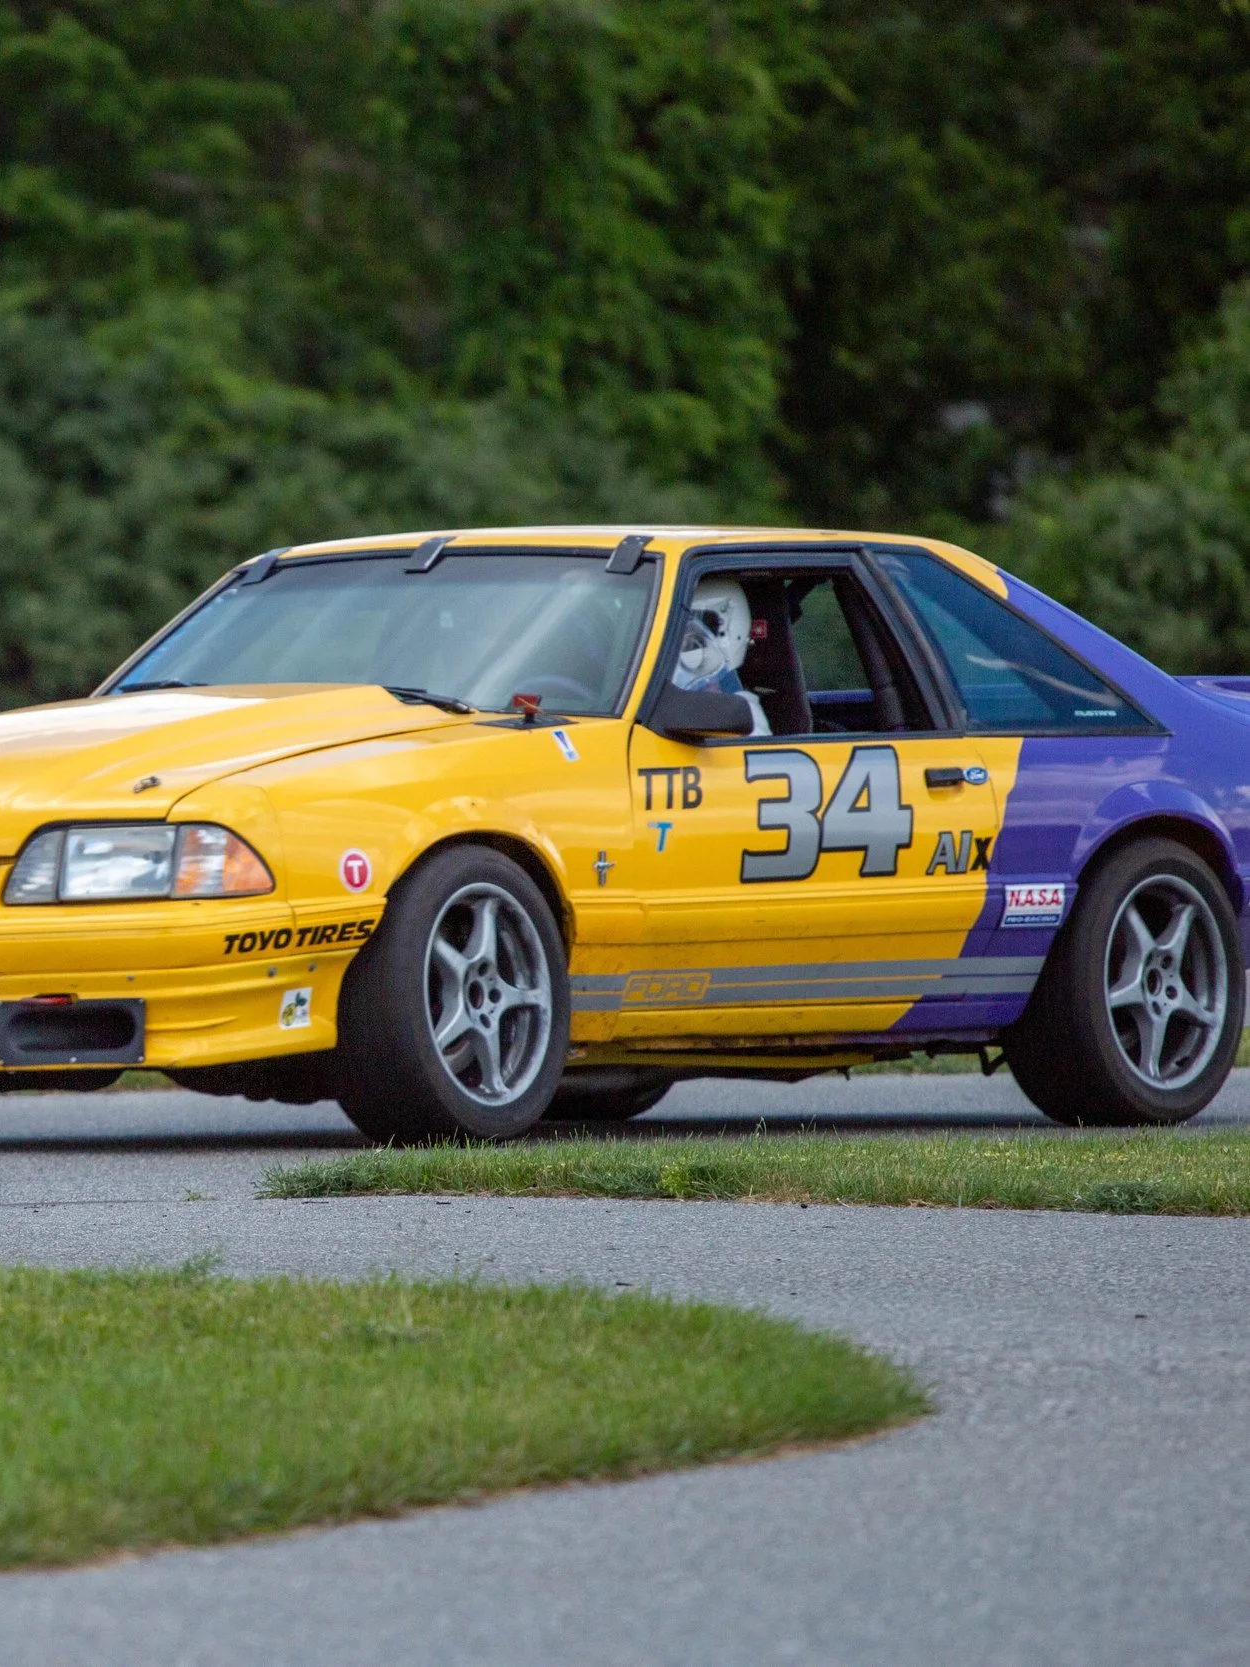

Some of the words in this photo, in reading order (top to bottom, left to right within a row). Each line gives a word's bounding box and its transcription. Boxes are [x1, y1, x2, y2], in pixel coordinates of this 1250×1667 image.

[637, 766, 703, 811] TTB
[740, 744, 914, 884] 34
[347, 859, 364, 885] T
[224, 928, 292, 955] TOYO
[296, 919, 375, 948] TIRES
